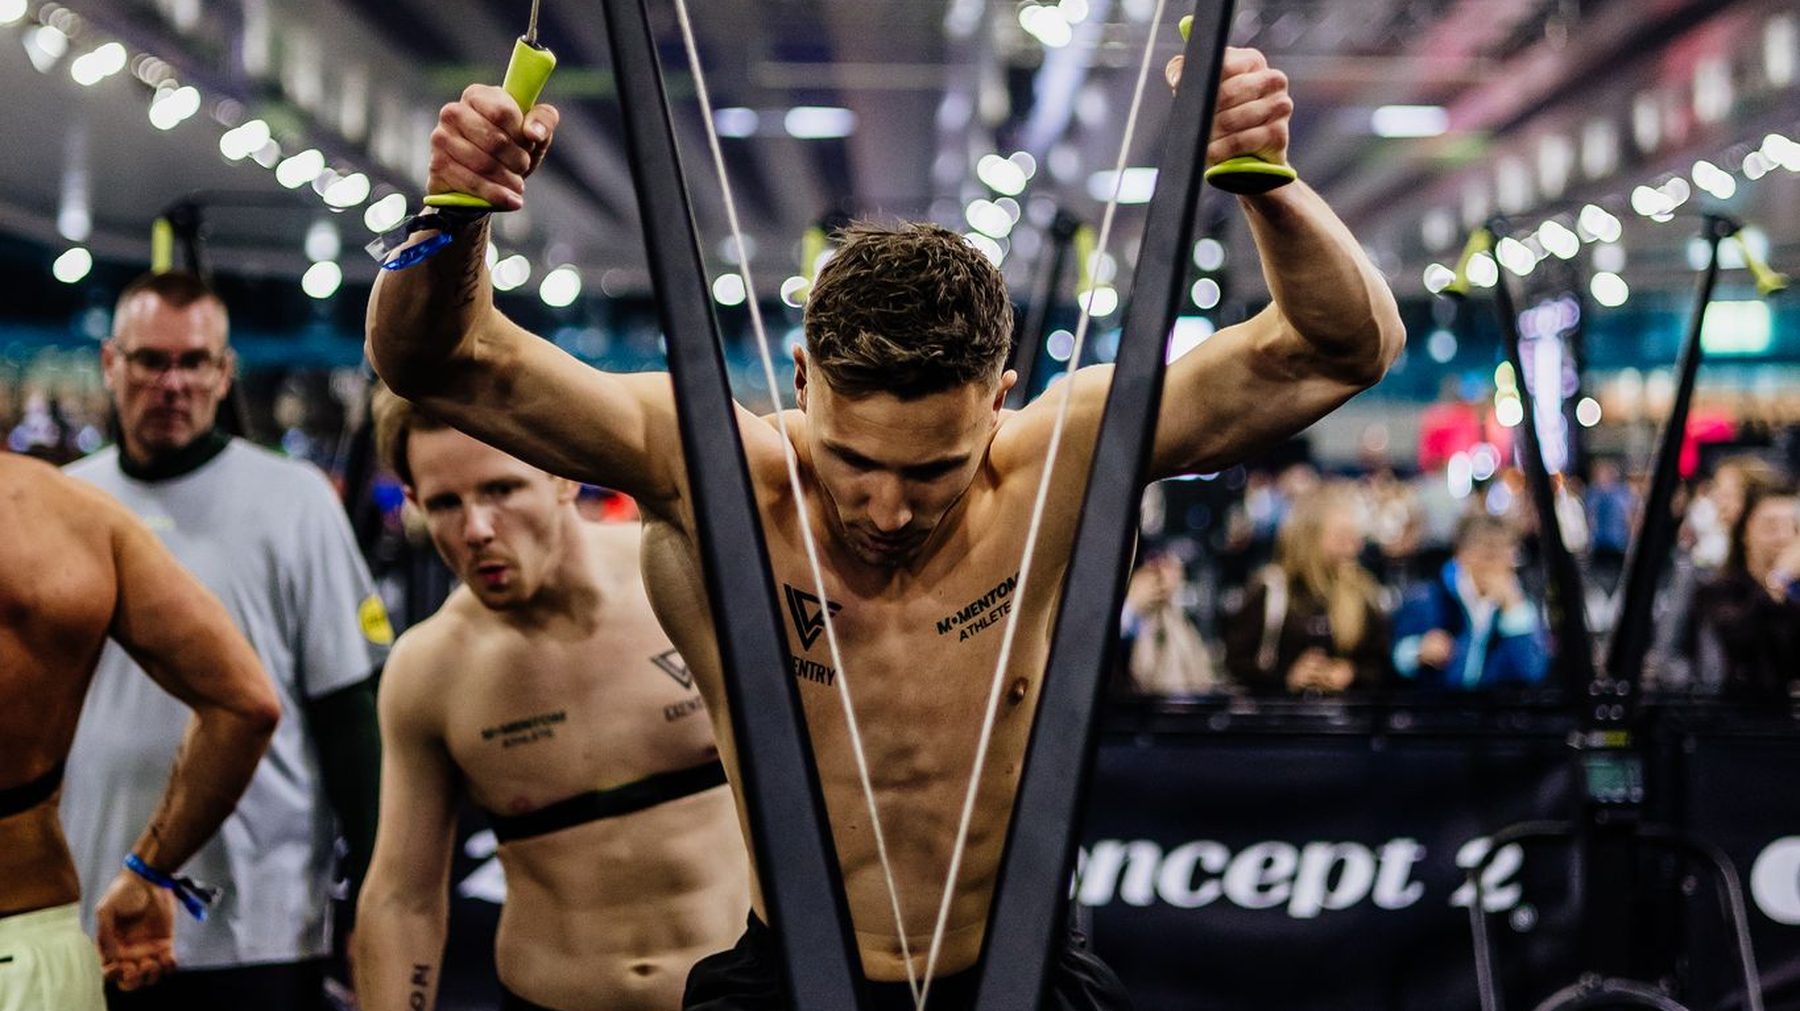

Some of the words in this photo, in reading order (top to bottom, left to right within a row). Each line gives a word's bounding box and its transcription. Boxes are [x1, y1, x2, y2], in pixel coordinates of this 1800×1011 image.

[960, 600, 1011, 642] ATHLETE
[1069, 838, 1426, 918] ncept
[1450, 837, 1524, 913] 2
